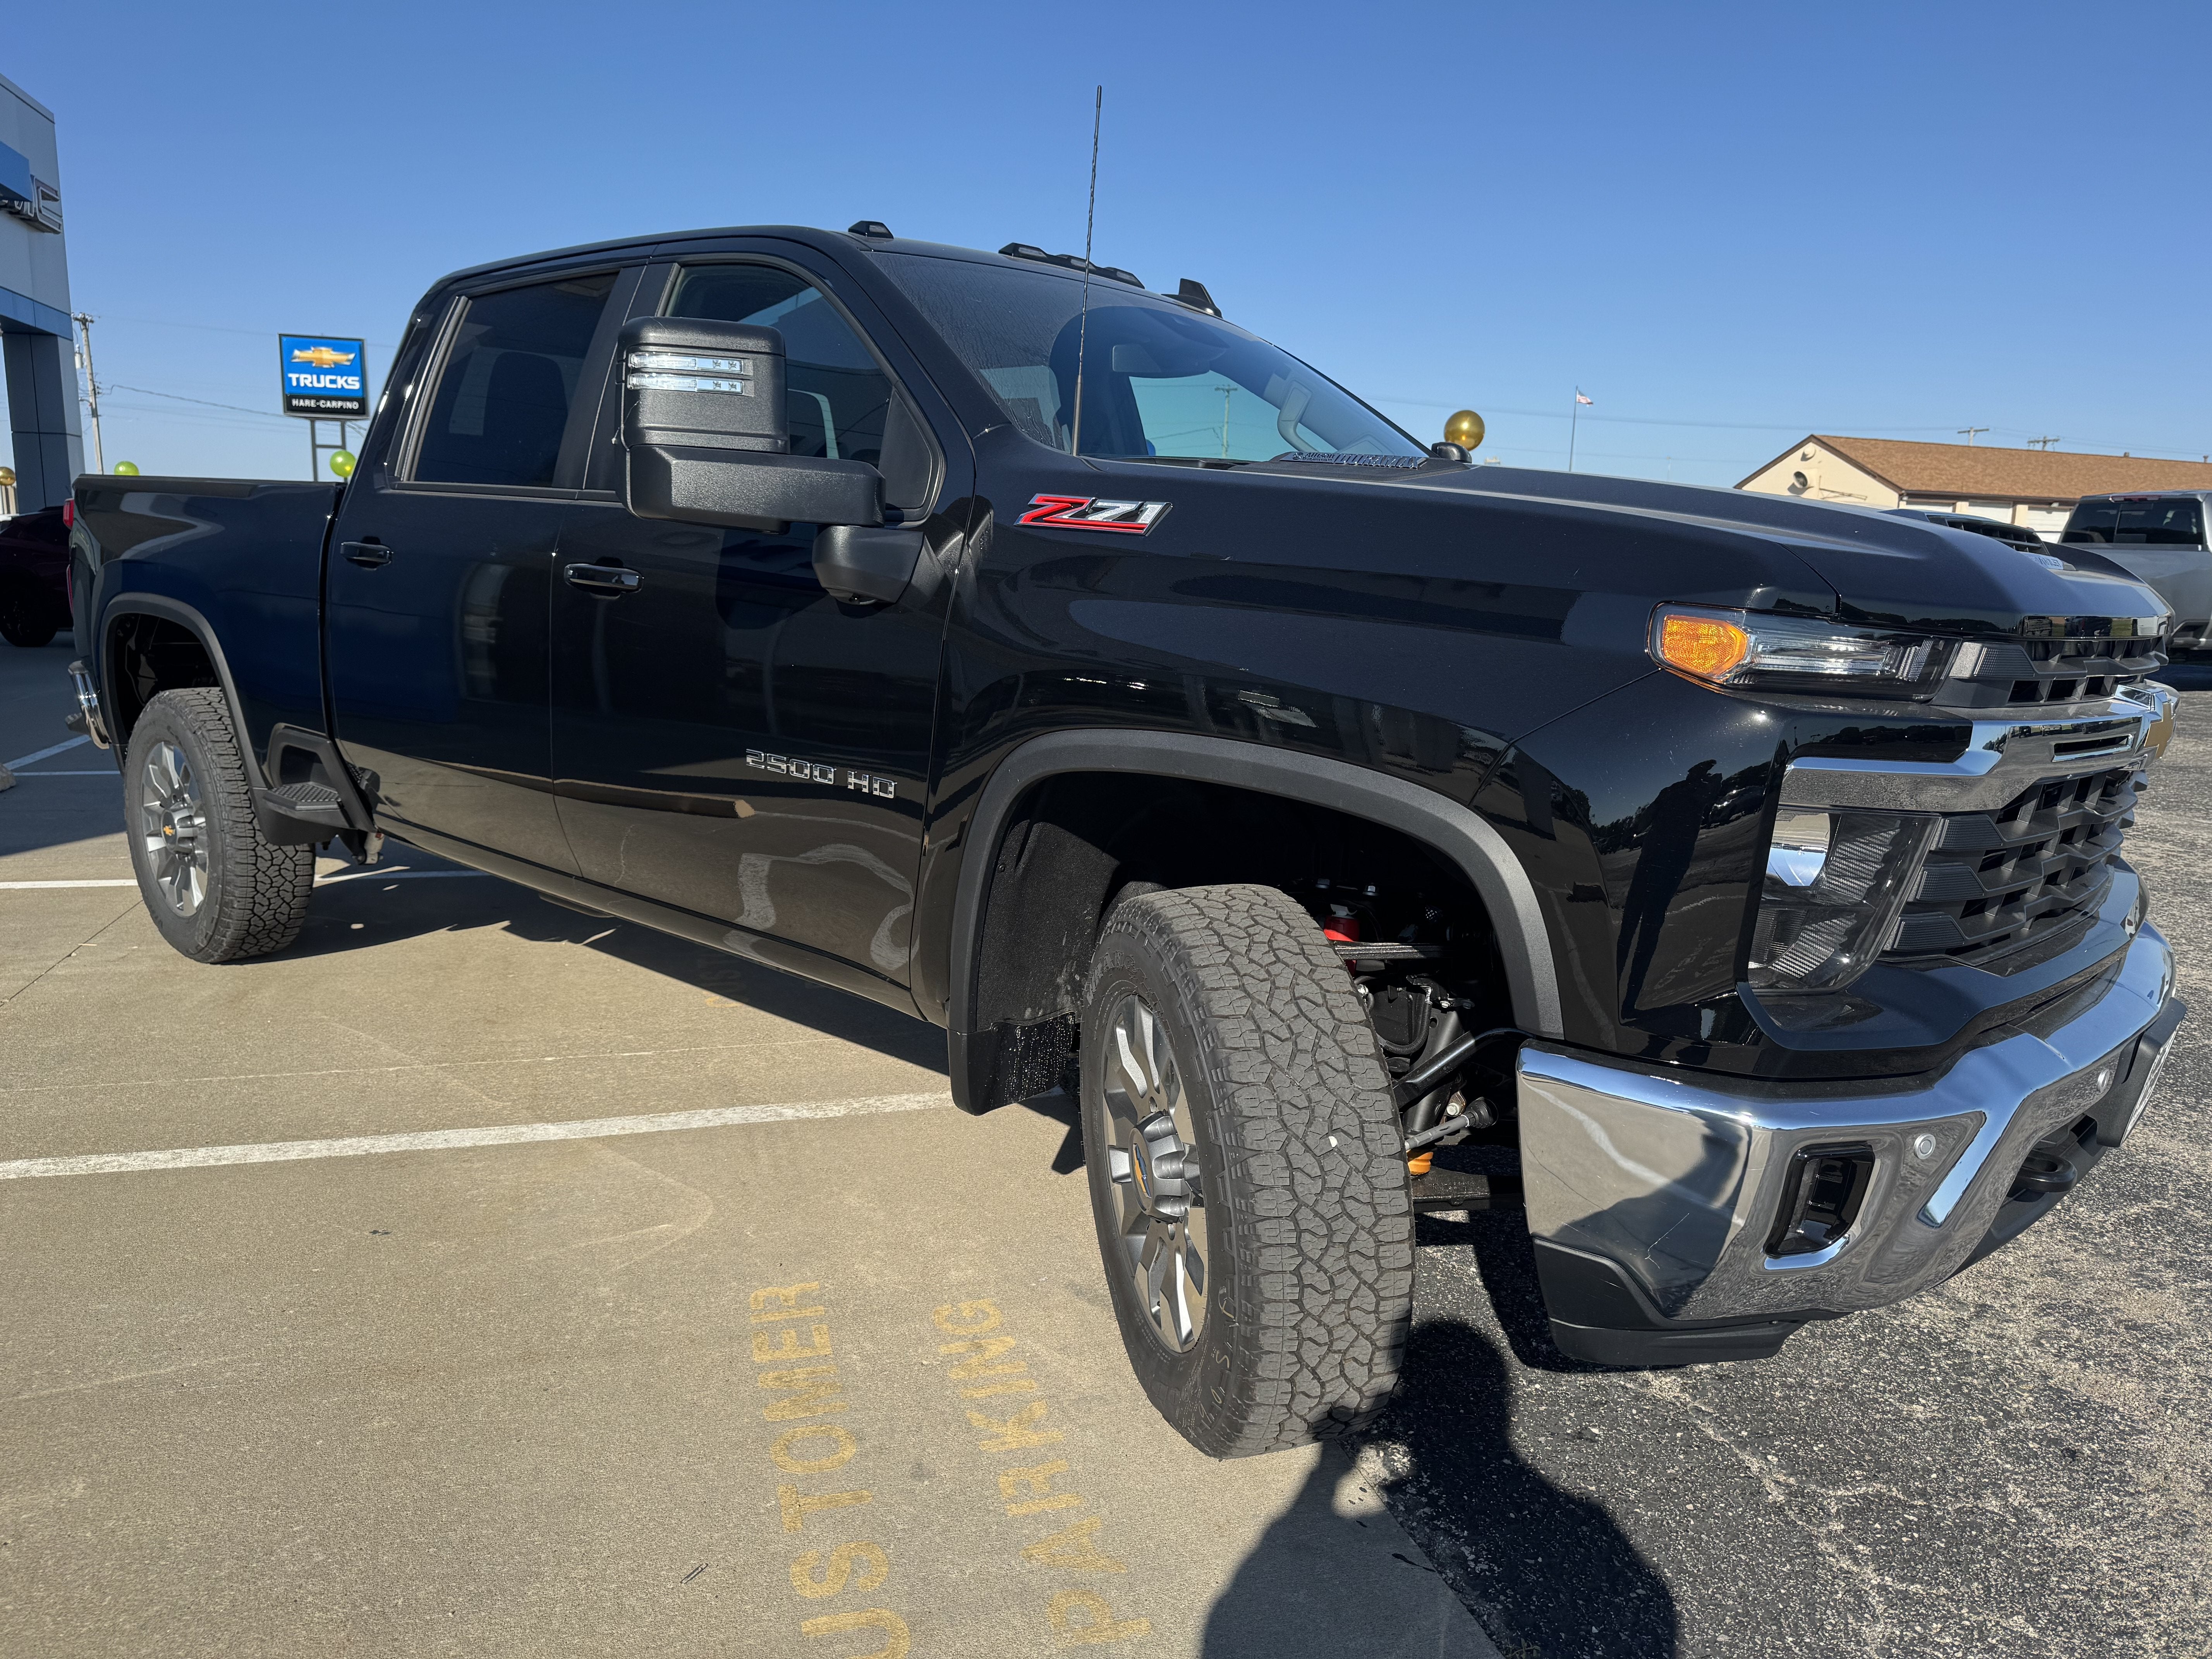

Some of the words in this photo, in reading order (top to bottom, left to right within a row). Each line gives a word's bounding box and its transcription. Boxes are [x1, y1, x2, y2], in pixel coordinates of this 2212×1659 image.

[288, 373, 360, 389] TRUCKS
[1334, 453, 1427, 470] DURAMAX
[1014, 493, 1173, 536] Z71
[746, 748, 835, 785] 2500
[847, 771, 896, 799] HD
[933, 1298, 1151, 1647] PARKING
